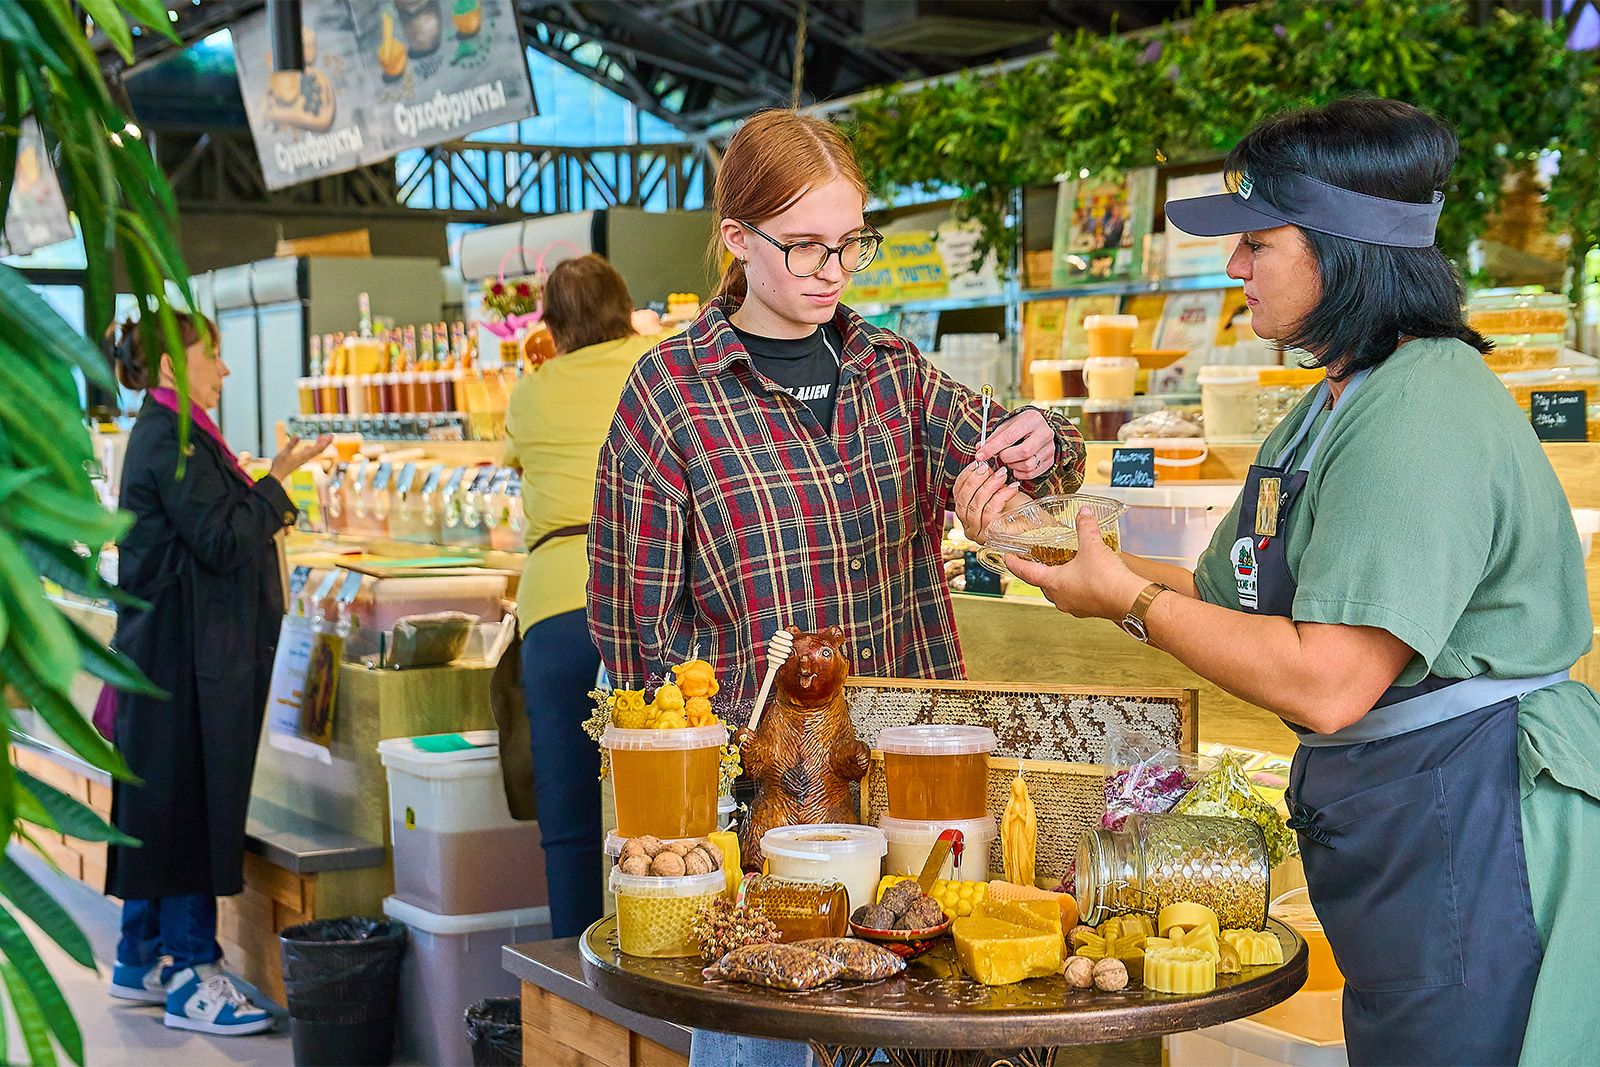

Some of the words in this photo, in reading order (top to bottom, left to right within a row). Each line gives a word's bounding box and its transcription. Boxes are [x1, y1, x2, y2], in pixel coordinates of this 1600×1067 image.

[394, 80, 507, 138] Сухофрукты
[275, 124, 364, 174] Сухофрукты
[796, 384, 831, 400] ALIEN
